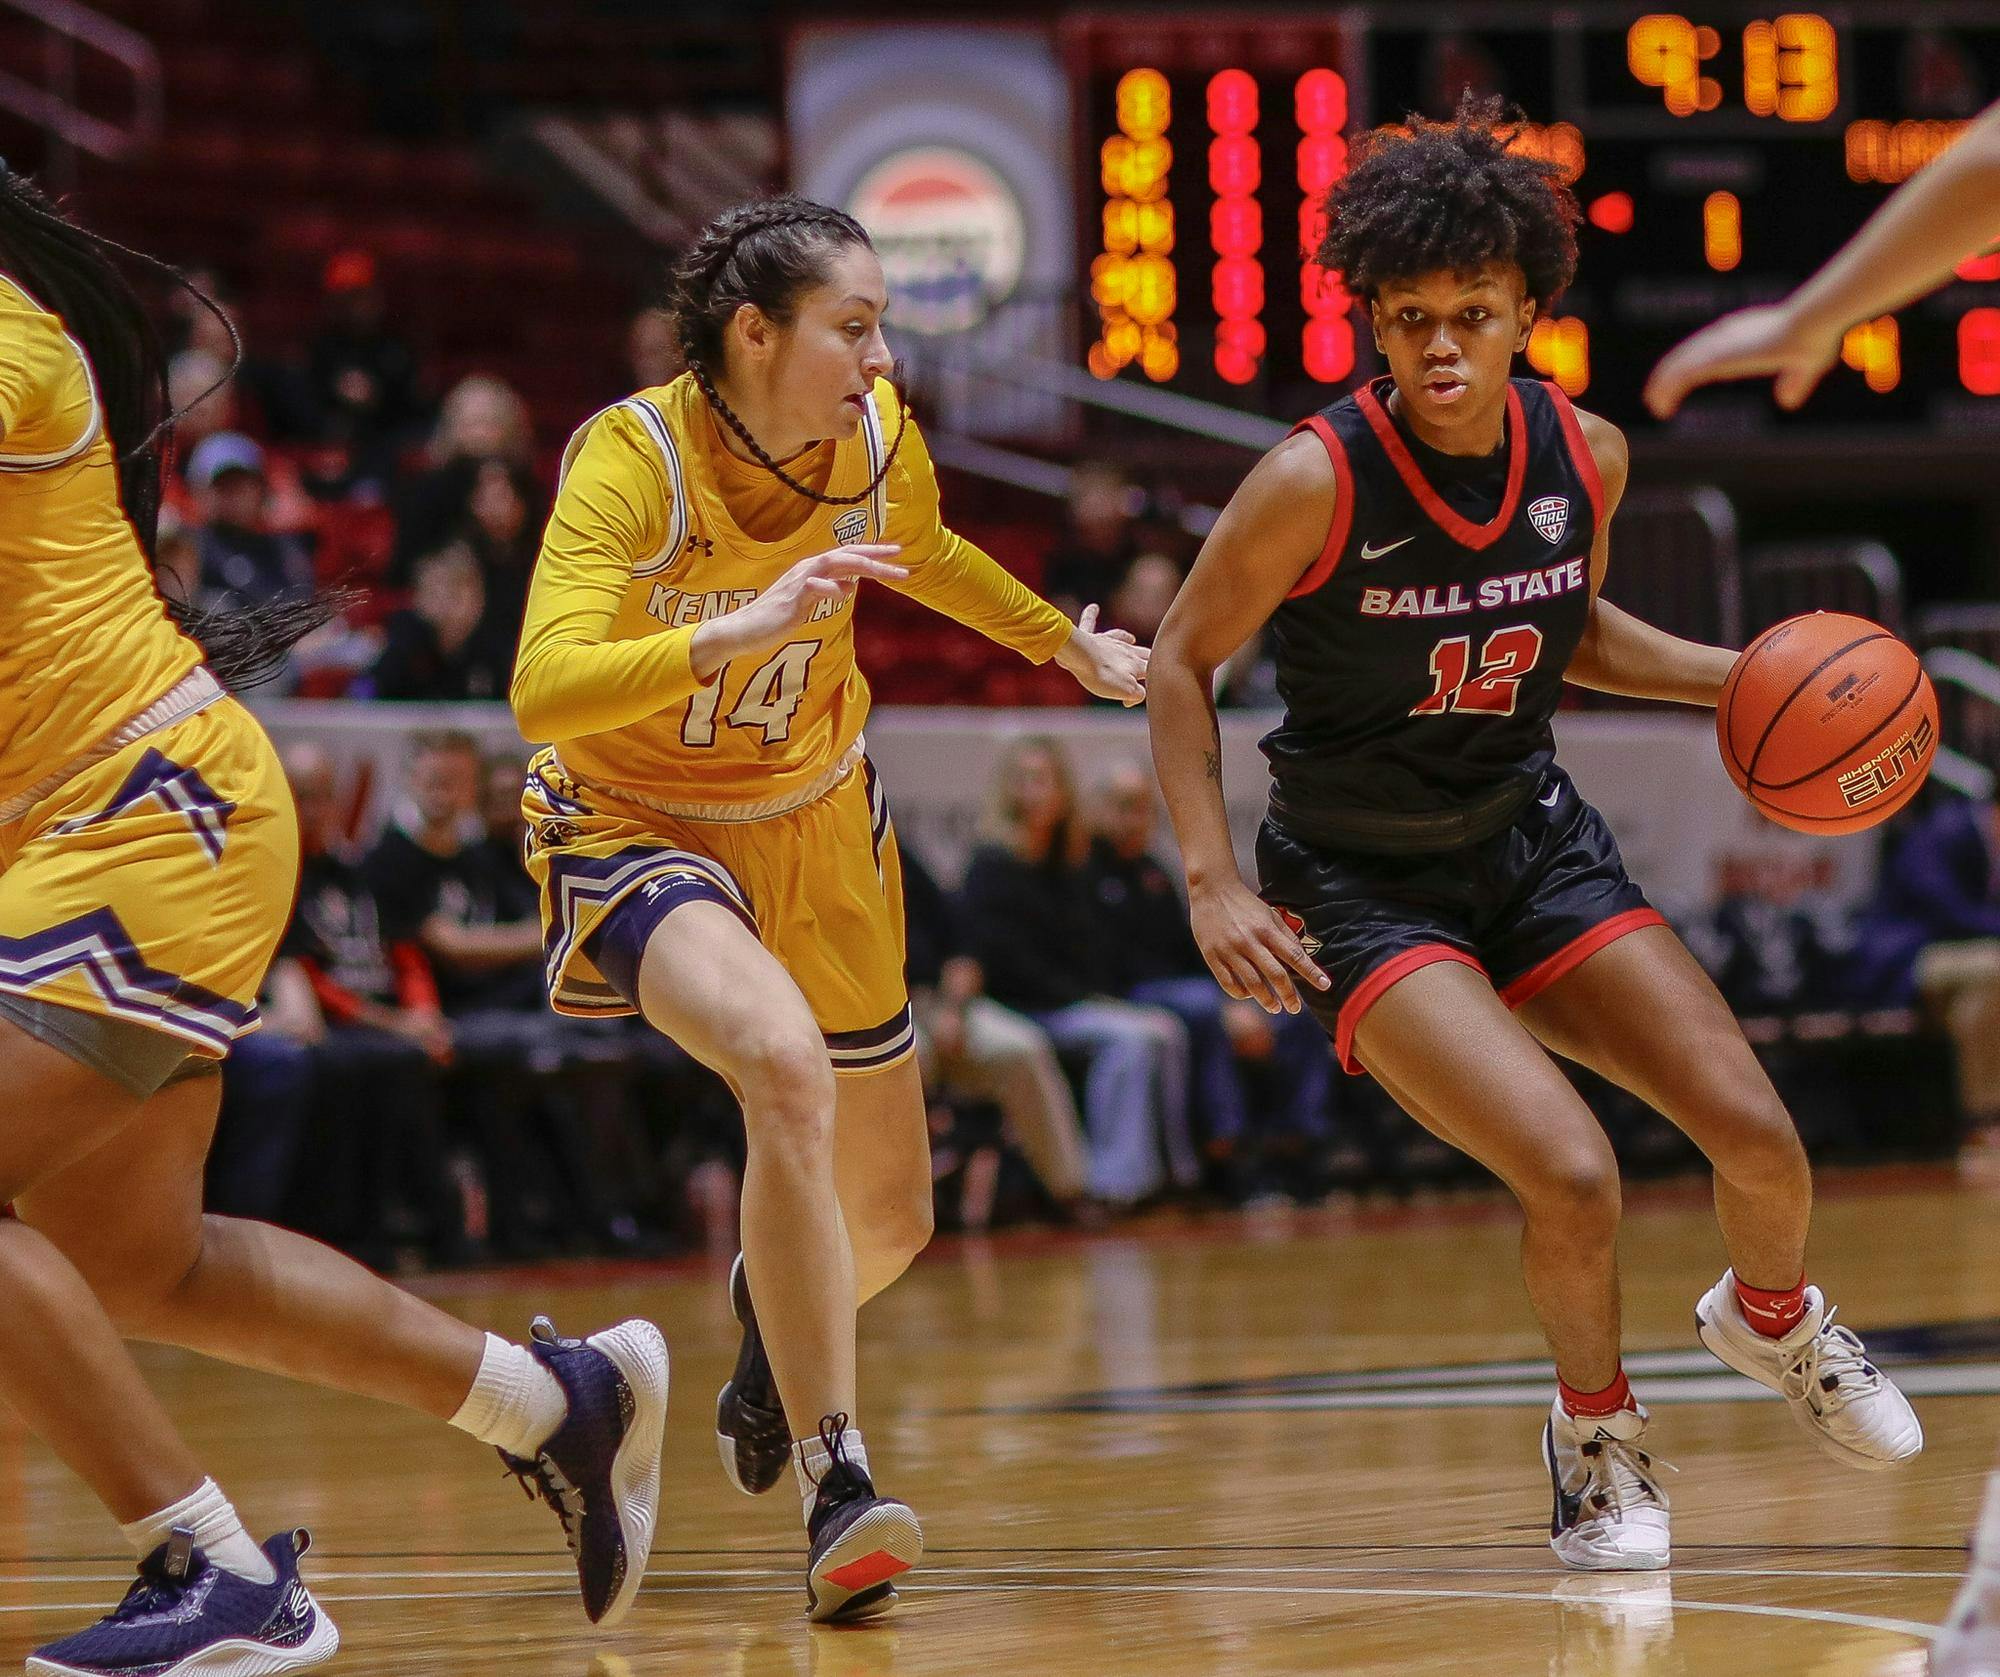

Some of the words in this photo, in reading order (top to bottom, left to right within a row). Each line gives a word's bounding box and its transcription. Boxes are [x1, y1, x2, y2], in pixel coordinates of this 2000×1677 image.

[1533, 509, 1567, 527] MAC
[1360, 586, 1471, 616] BALL
[1478, 557, 1584, 608] STATE
[681, 638, 823, 748] 14
[1407, 623, 1543, 717] 12
[1839, 713, 1934, 809] ELITE
